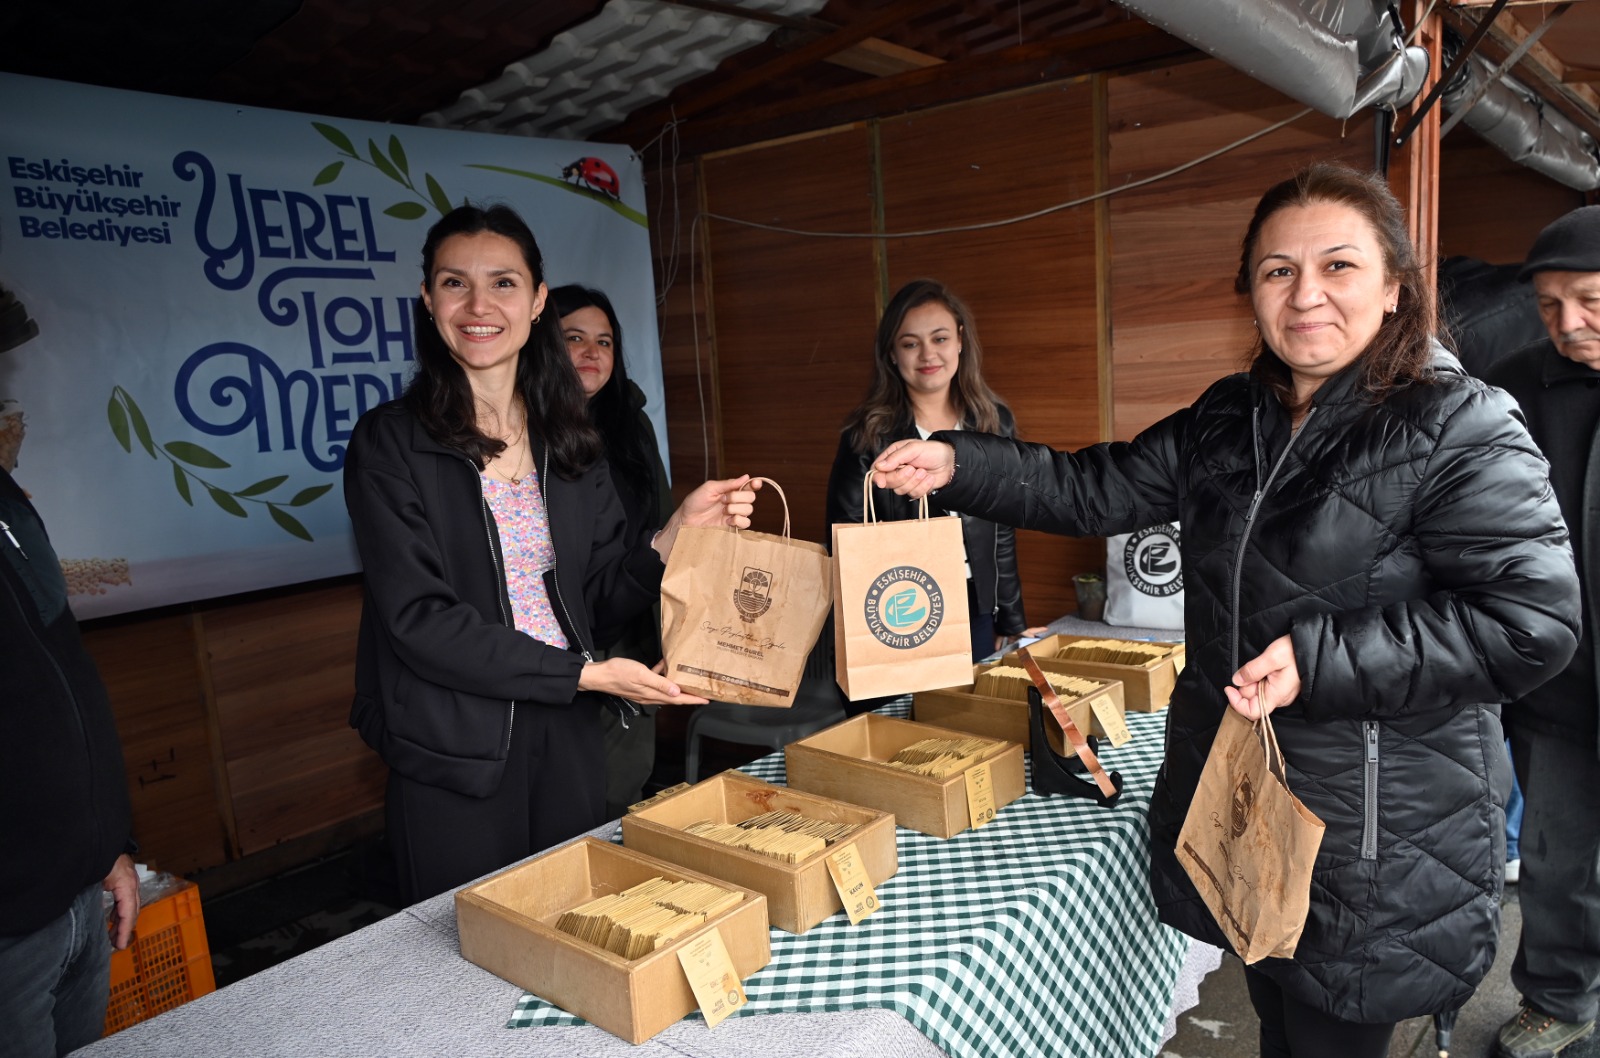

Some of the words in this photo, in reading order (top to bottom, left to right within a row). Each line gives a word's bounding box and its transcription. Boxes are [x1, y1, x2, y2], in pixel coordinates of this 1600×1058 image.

[7, 156, 144, 188] Eskişehir
[13, 186, 182, 218] Büyükşehir
[19, 215, 172, 247] Belediyesi
[172, 150, 396, 291] YEREL
[257, 266, 422, 369] TOH
[876, 568, 927, 591] ESKİŞEHİR
[867, 597, 911, 648] BÜYÜKŞEHİR
[912, 591, 942, 645] BELEDİYESİ
